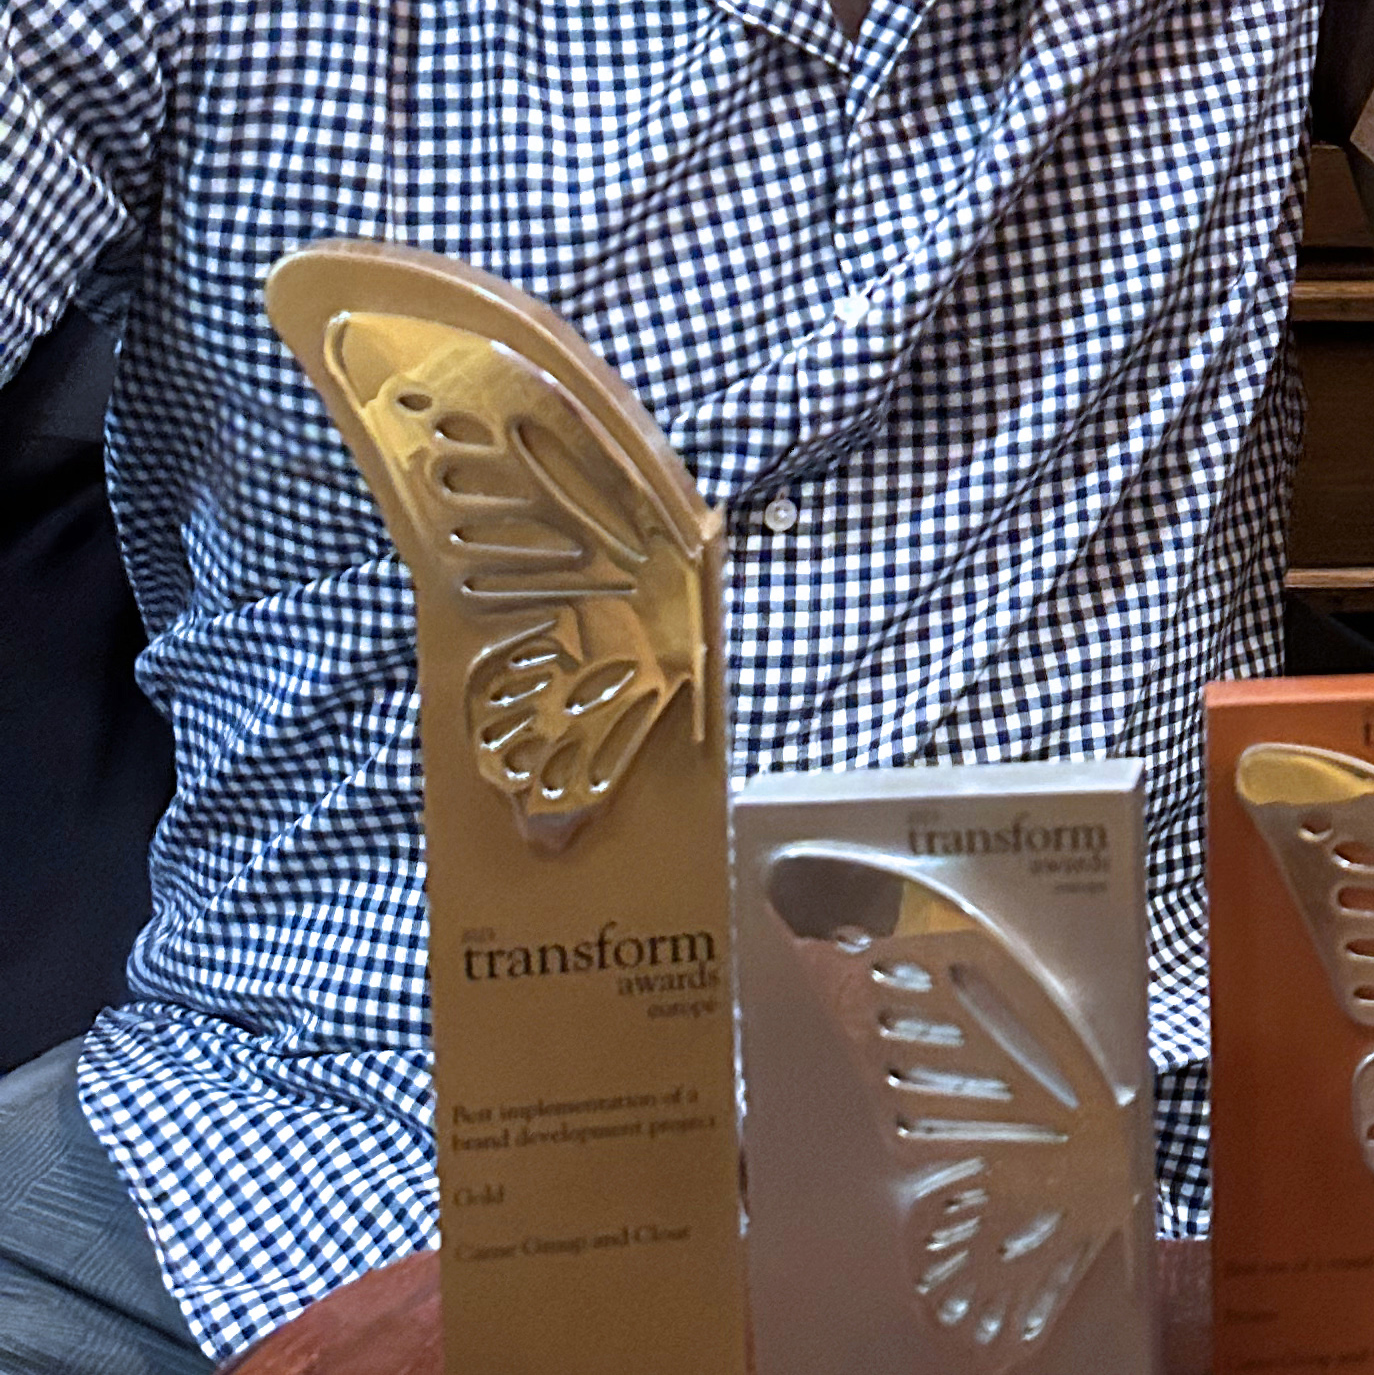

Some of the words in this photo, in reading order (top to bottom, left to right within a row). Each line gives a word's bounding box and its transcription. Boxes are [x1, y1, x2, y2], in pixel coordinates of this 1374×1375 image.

[908, 810, 1109, 856] transform
[464, 920, 716, 981] transform
[618, 964, 721, 997] awards
